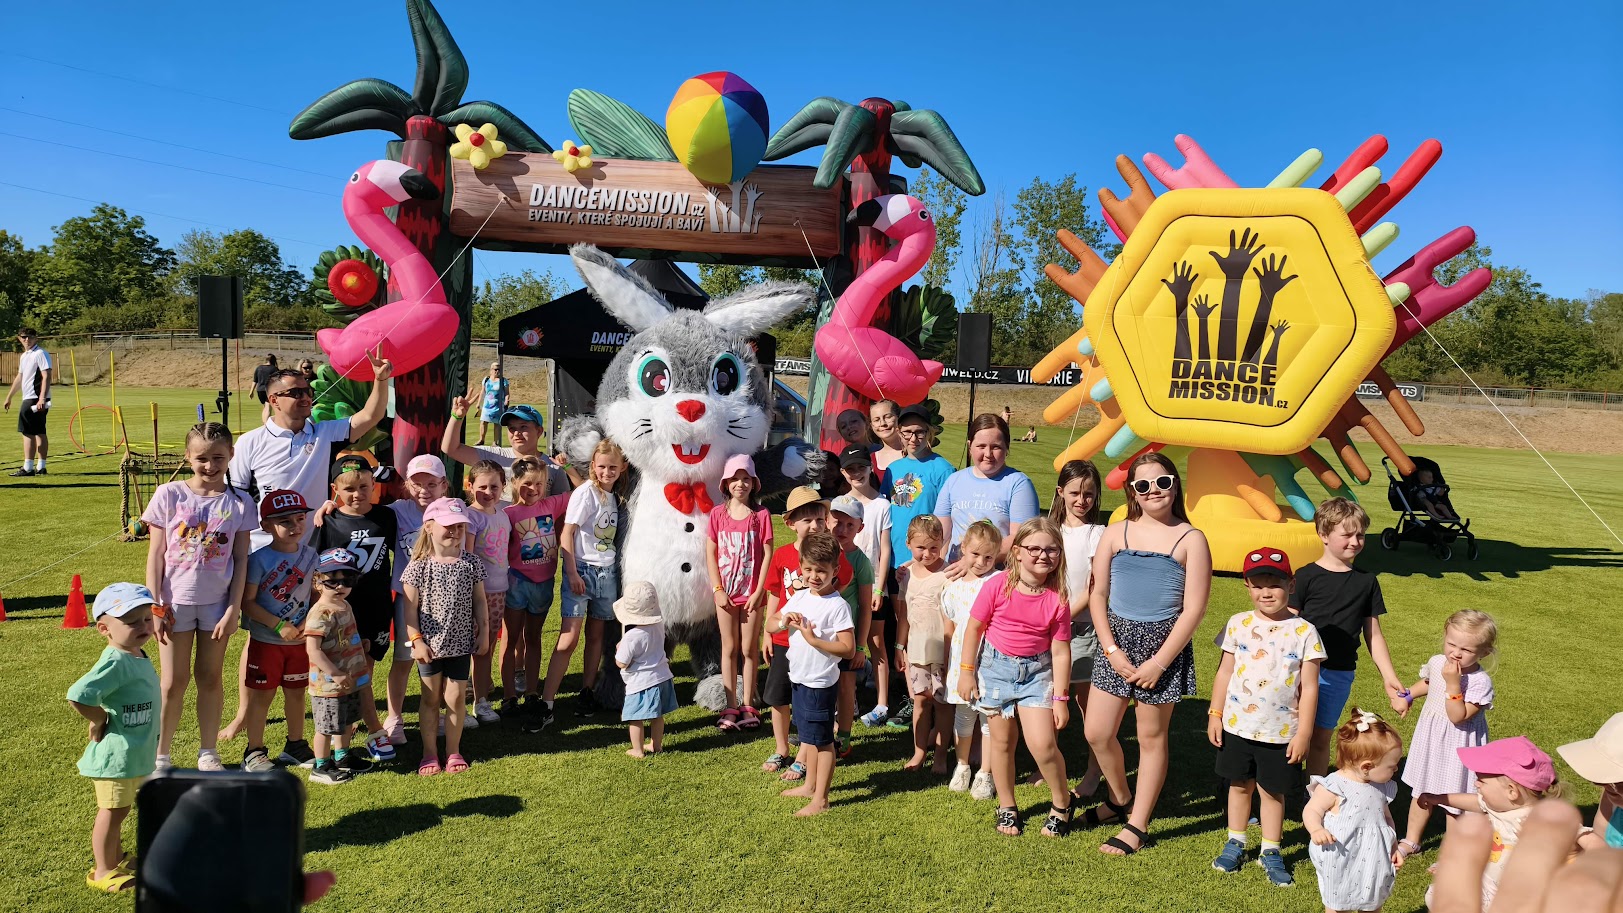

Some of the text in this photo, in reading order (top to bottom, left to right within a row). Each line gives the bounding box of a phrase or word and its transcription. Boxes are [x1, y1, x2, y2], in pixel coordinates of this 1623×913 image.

[528, 209, 706, 231] EVENTY, KTERÉ SPOJUJÍ A BAVÍ
[591, 331, 634, 345] DANCE
[1171, 360, 1277, 386] DANCE
[351, 529, 370, 539] SIX
[373, 543, 388, 571] SEVEN
[277, 559, 290, 572] OFF
[122, 701, 153, 713] THE BEST
